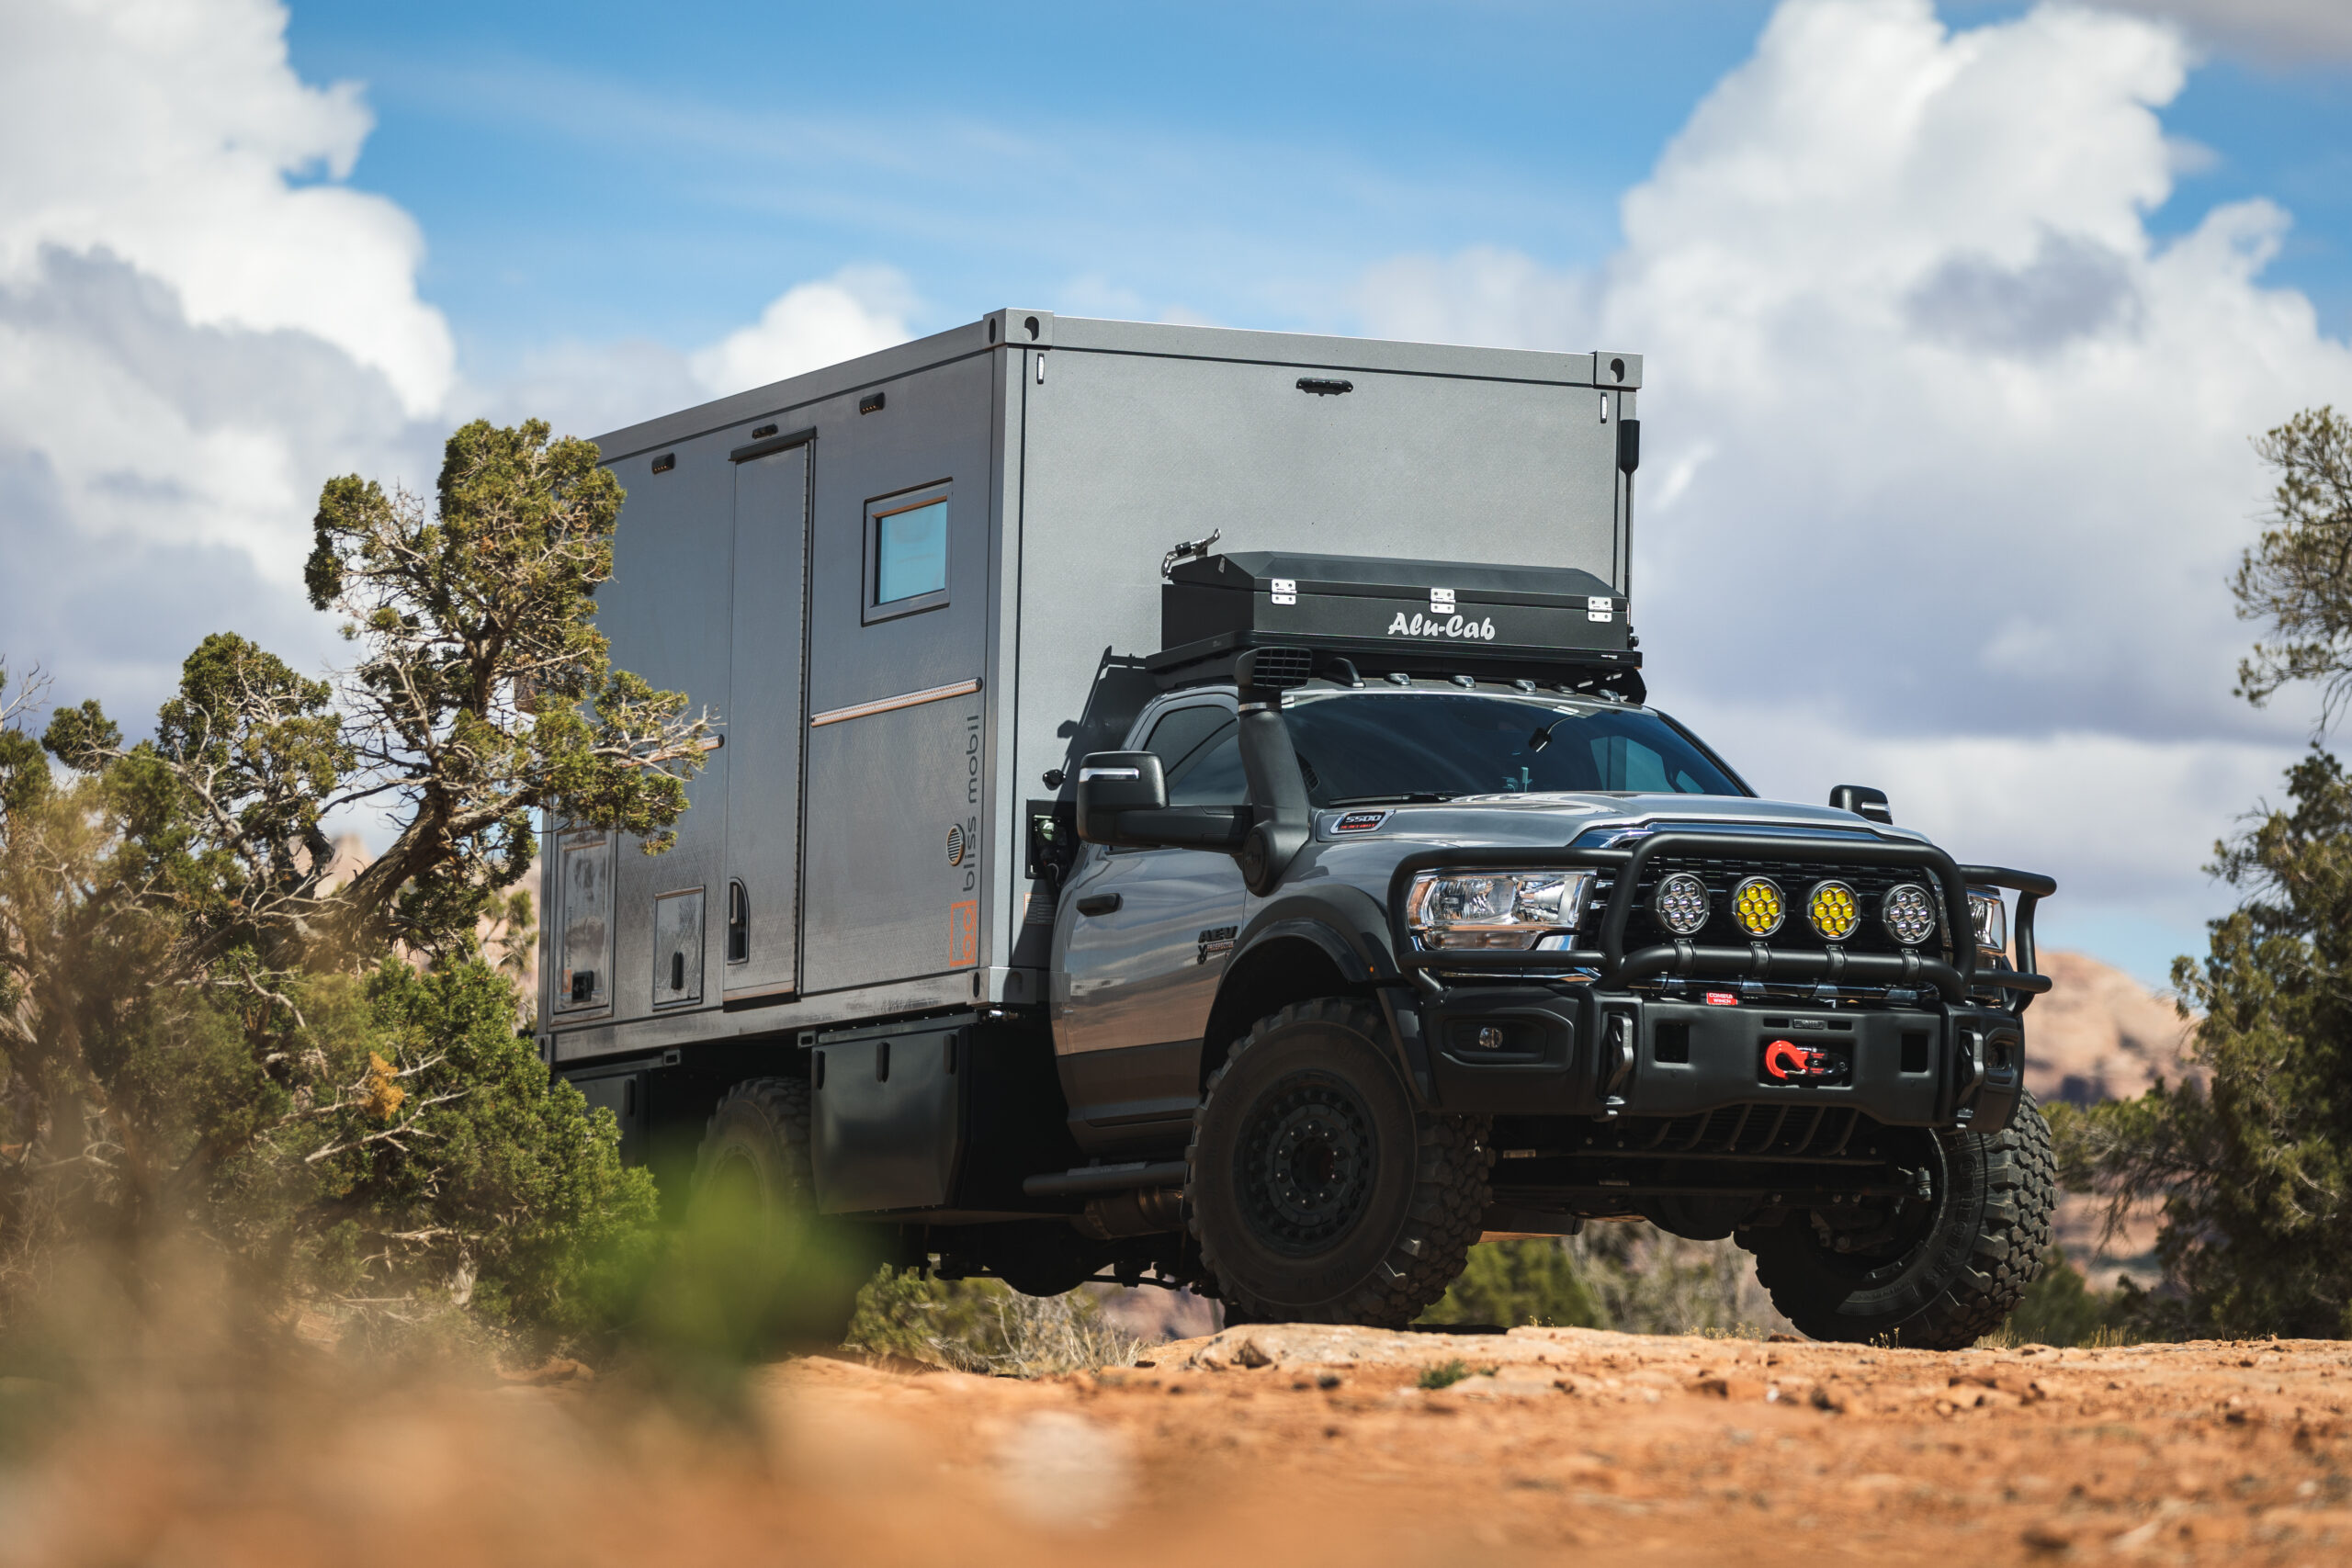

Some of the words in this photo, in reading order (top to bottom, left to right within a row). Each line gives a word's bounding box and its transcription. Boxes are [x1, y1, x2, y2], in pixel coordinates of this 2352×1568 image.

[1388, 613, 1496, 641] Alu-Cab
[966, 715, 979, 804] mobil
[1345, 815, 1382, 823] 5500
[962, 816, 977, 893] bliss
